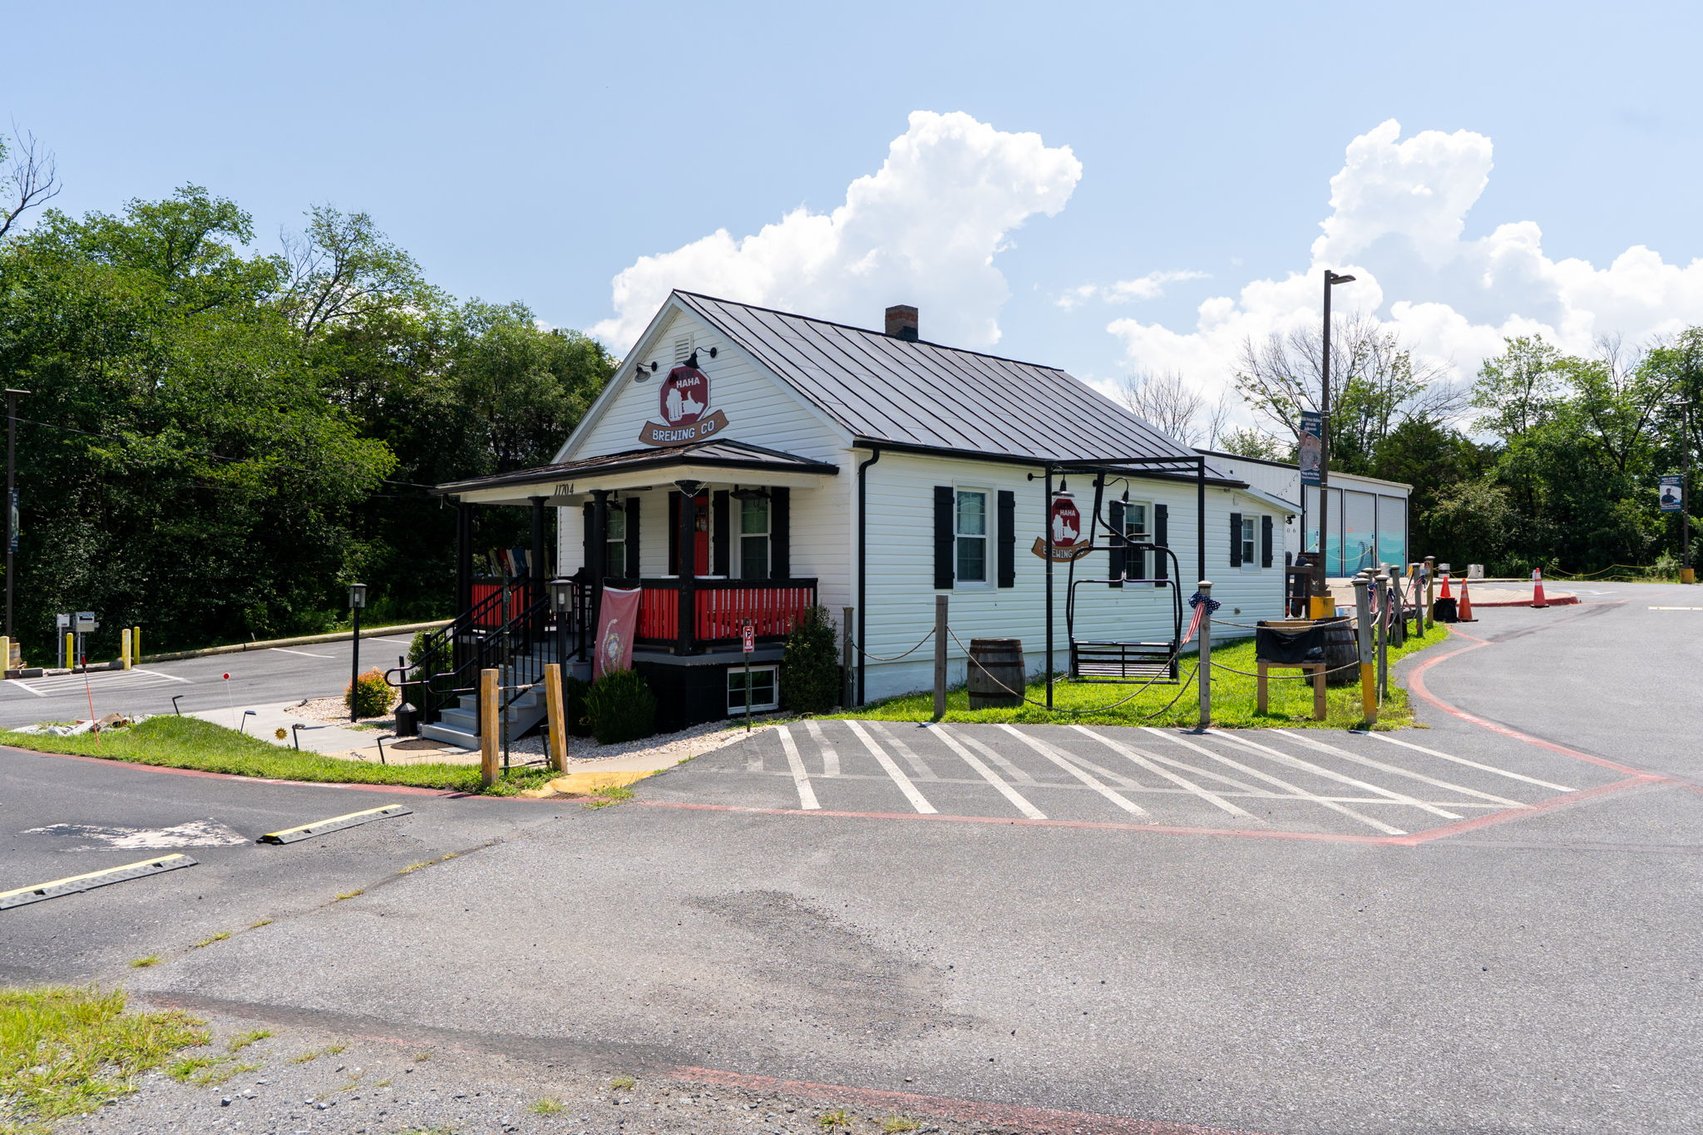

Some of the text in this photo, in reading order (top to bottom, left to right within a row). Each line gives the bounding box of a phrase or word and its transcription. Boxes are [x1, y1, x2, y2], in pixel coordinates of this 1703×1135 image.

[676, 377, 700, 388] HAHA
[653, 420, 715, 441] BREWING CO
[1043, 546, 1073, 558] BEWING
